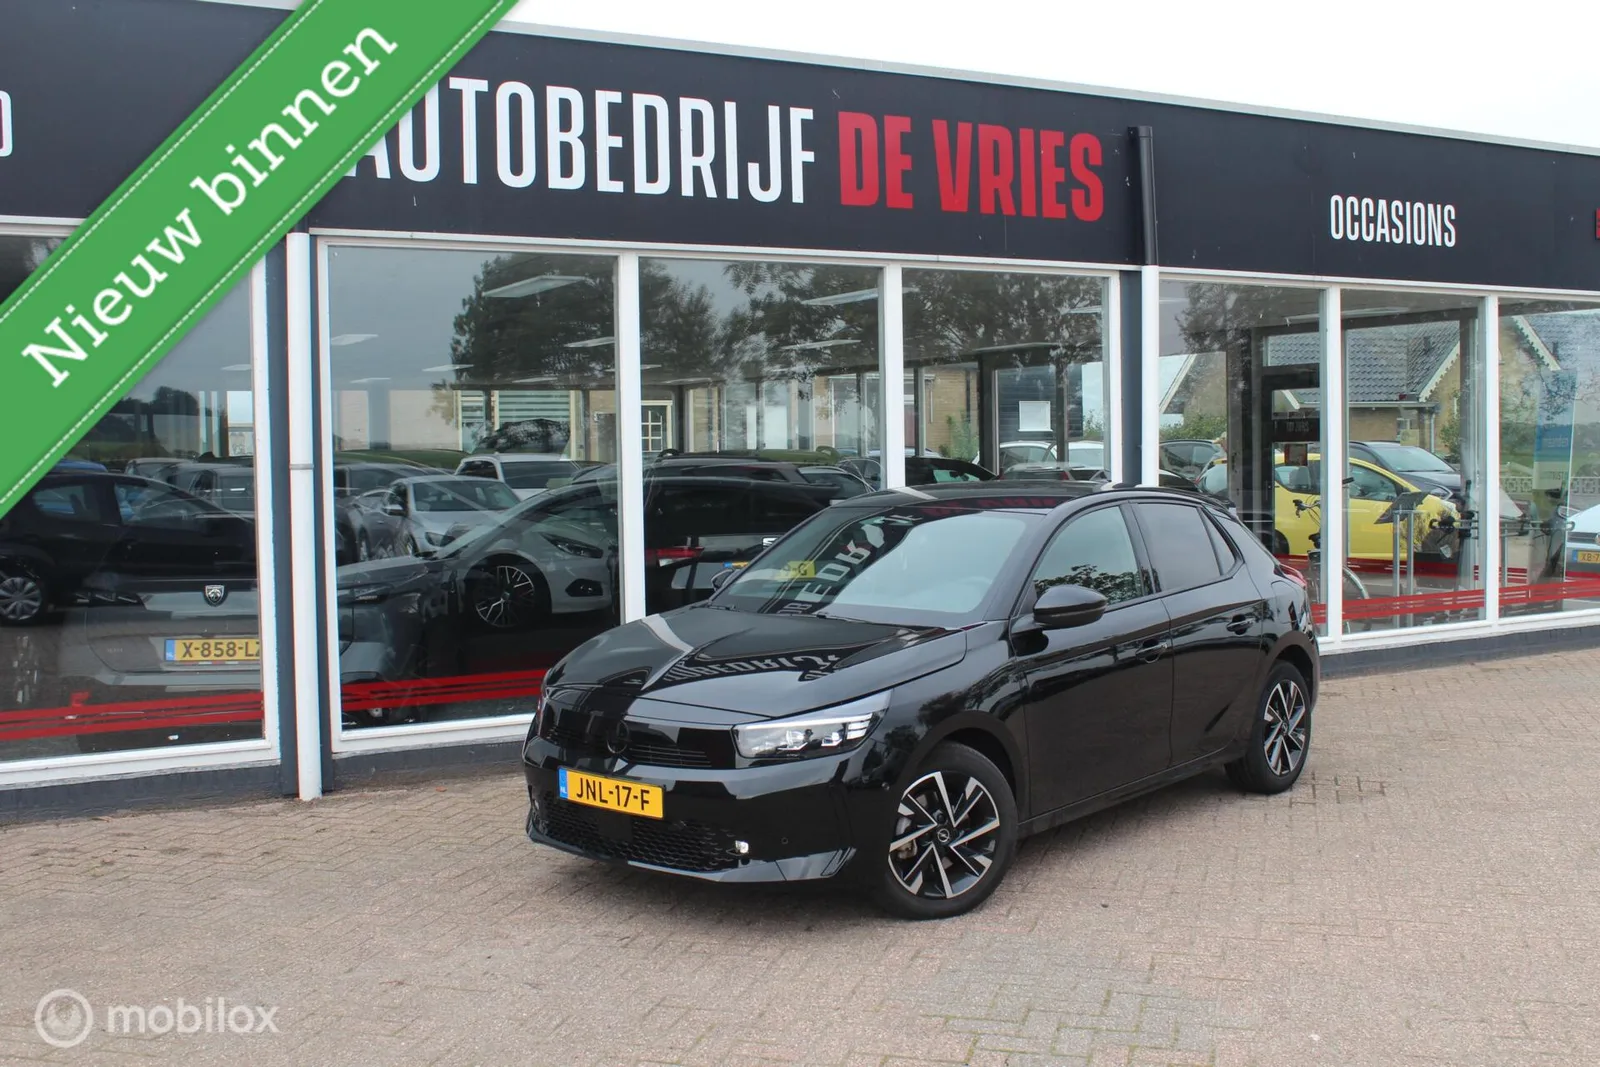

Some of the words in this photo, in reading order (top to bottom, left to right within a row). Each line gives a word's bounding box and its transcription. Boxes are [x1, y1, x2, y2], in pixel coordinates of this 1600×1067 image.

[838, 111, 913, 209] DE
[932, 119, 1104, 222] VRIES
[1330, 194, 1456, 248] OCCASIONS
[576, 777, 650, 811] JNL-17-F
